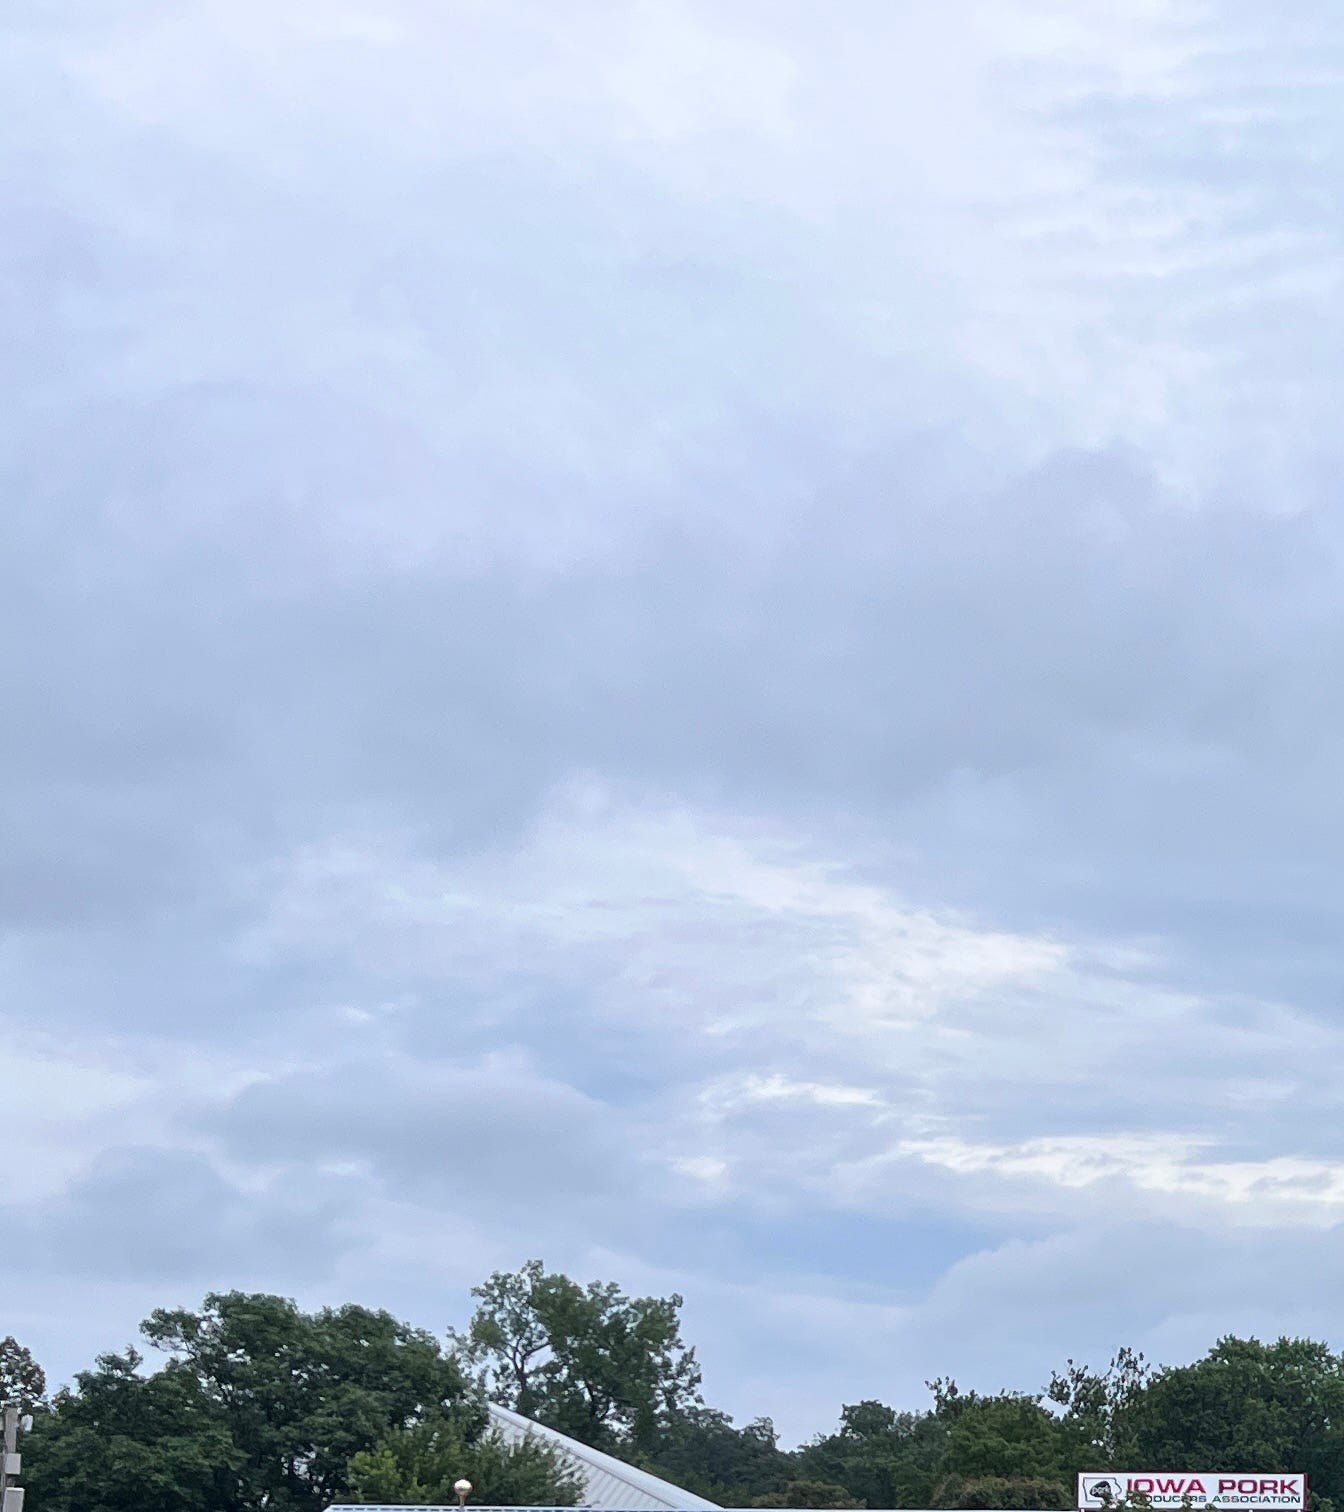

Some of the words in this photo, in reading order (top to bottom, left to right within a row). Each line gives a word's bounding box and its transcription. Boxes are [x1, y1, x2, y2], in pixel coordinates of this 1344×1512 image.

[1127, 1478, 1206, 1494] IOWA
[1218, 1479, 1299, 1495] PORK
[1212, 1495, 1301, 1504] ASSOCIATION
